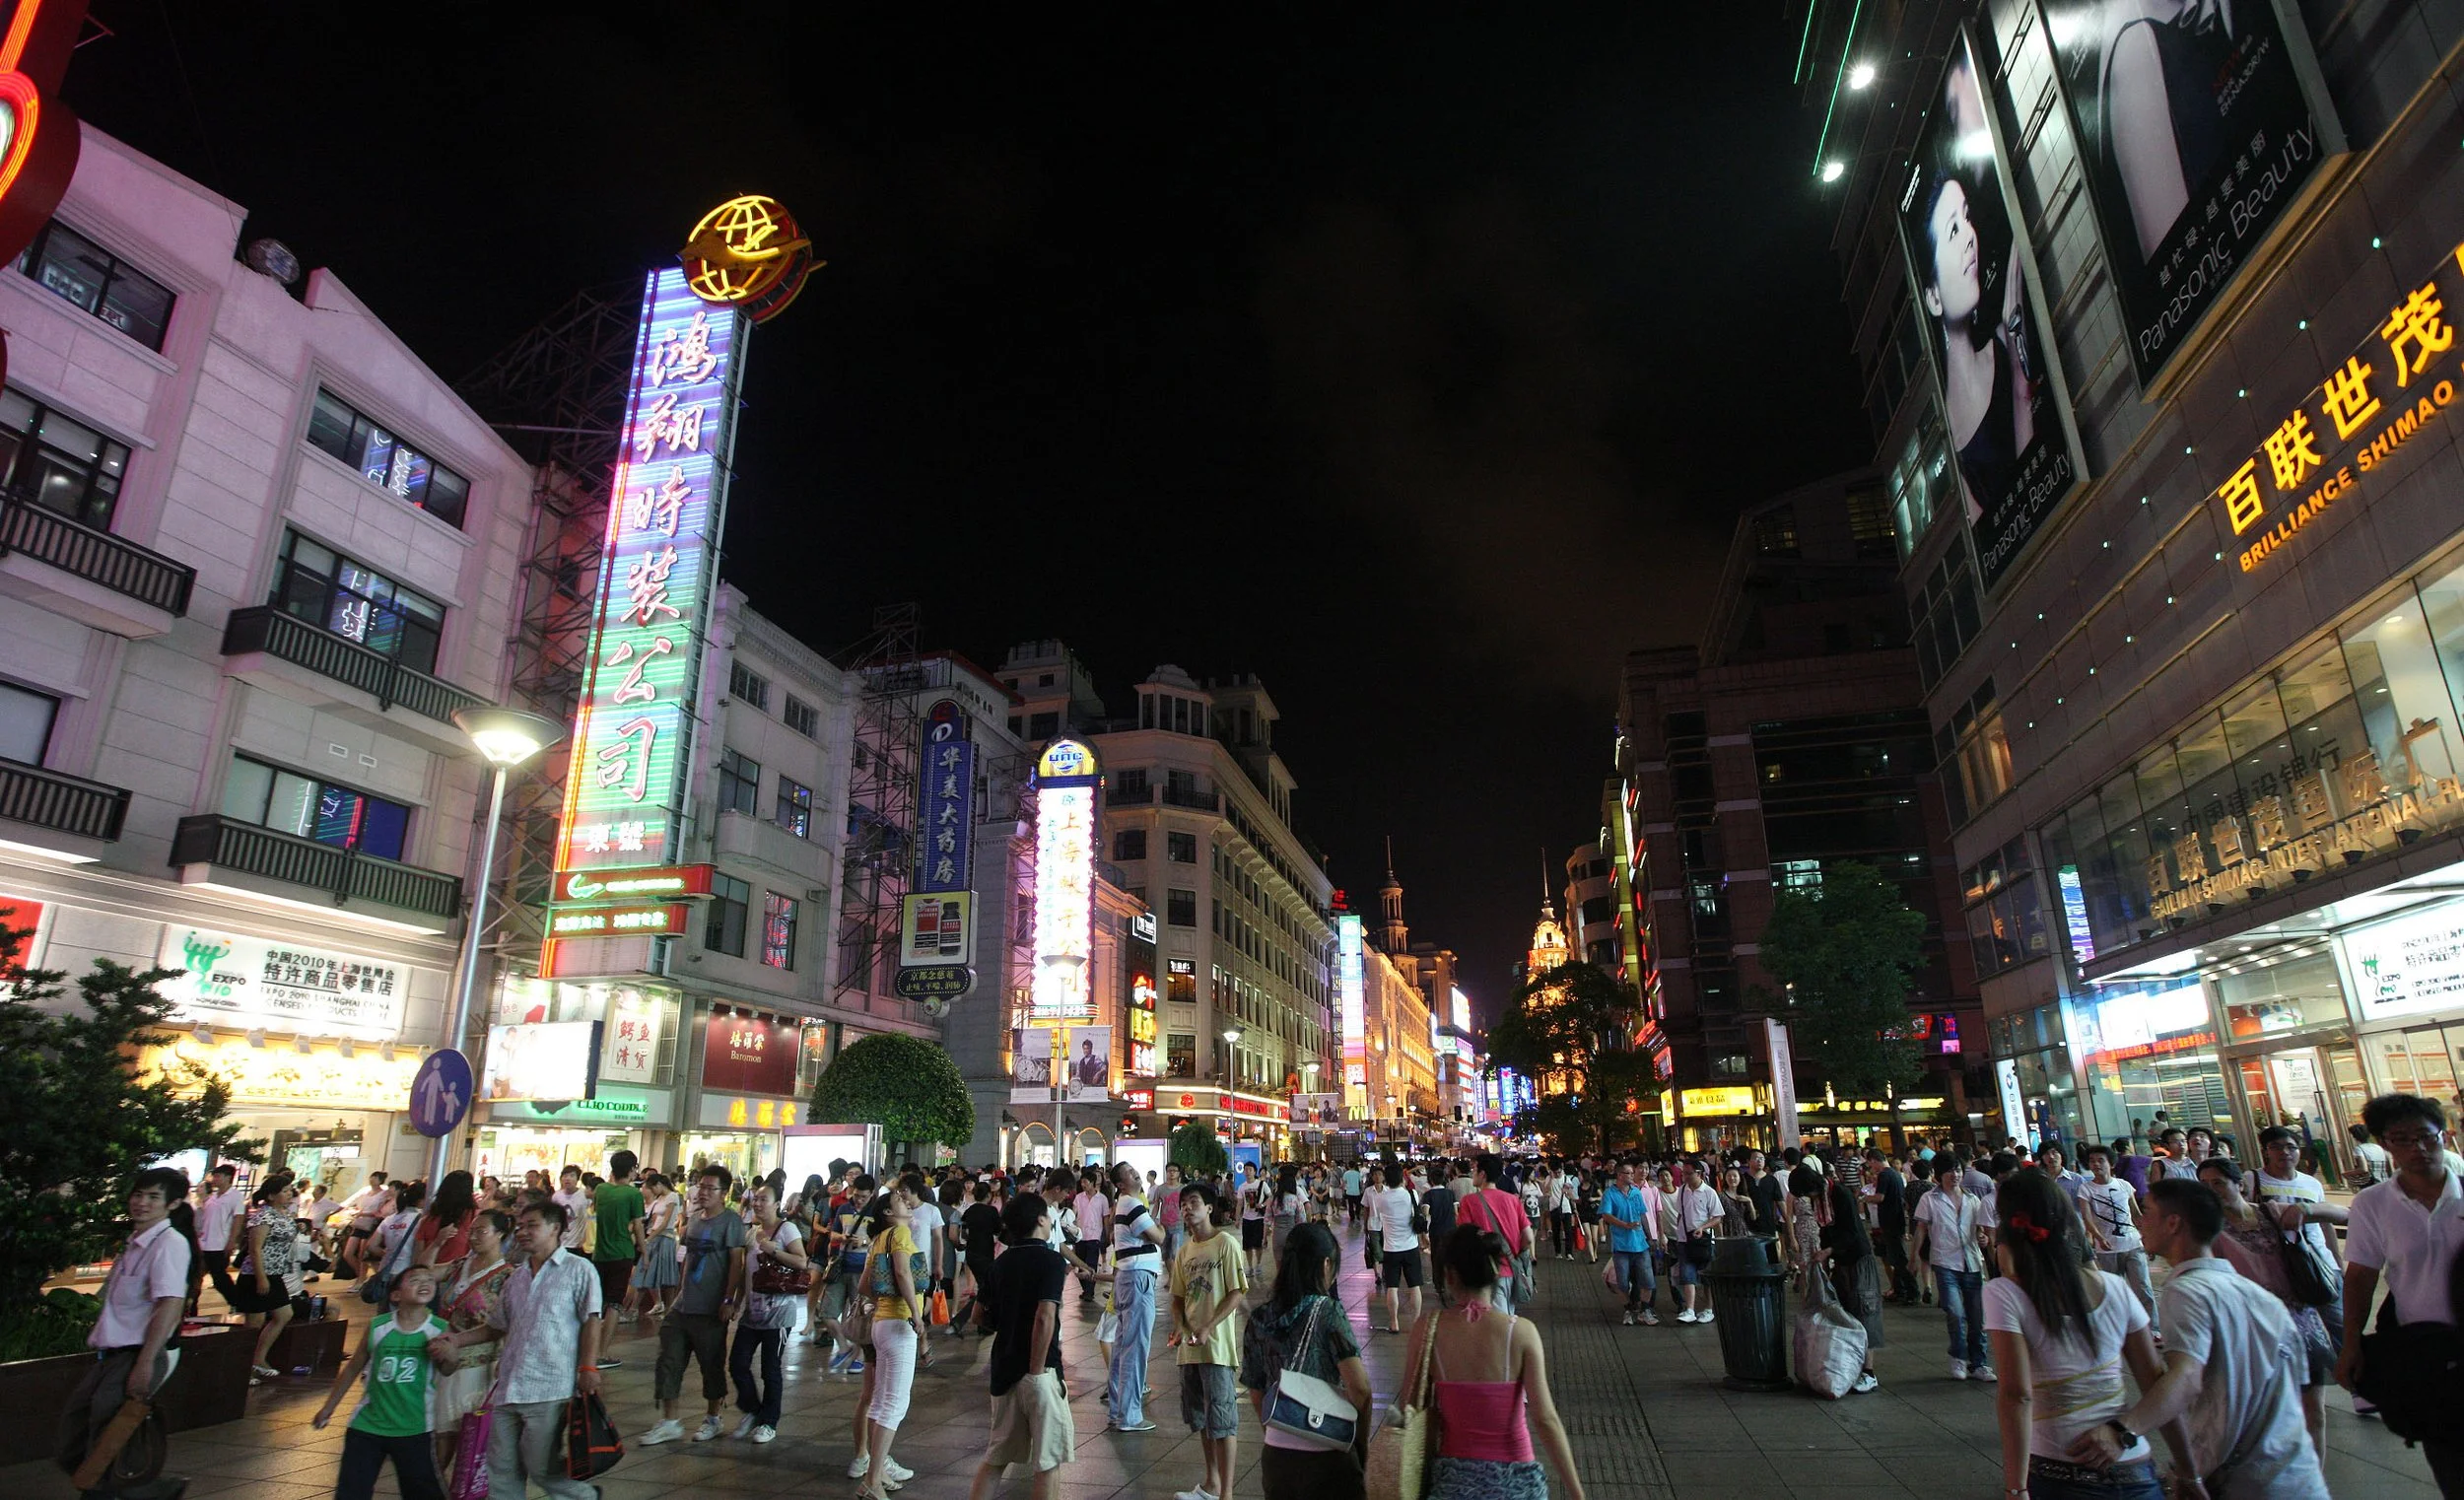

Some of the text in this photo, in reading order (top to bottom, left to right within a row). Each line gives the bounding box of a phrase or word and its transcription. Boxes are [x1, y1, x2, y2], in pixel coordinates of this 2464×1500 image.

[2139, 111, 2315, 363] Panasonic Beauty
[2219, 242, 2464, 536] 百联世茂
[2239, 379, 2453, 573] BRILLIANCE SHIMAO
[1982, 446, 2071, 577] Panasonic Beauty
[212, 973, 246, 986] EXPO
[263, 962, 393, 996] 特许商品零售店
[266, 949, 394, 981] 中国2010年上海世博会
[730, 1051, 762, 1063] Baromon
[579, 1099, 605, 1110] CLIO
[377, 1356, 418, 1383] 02
